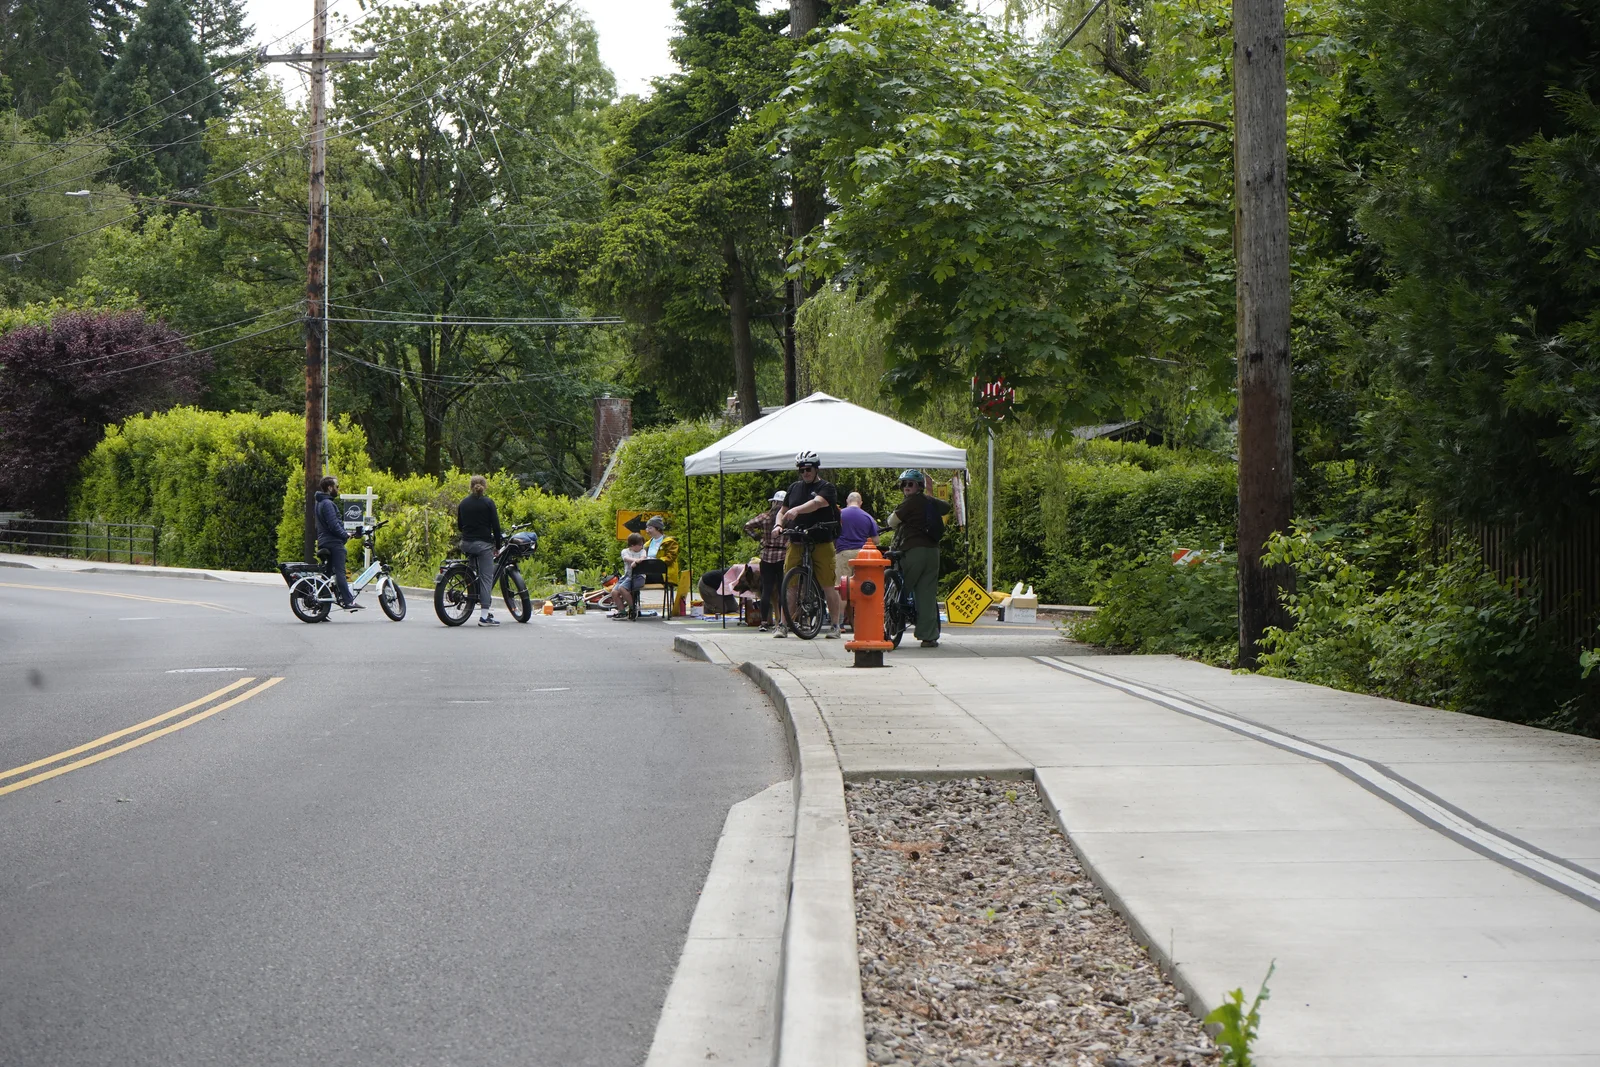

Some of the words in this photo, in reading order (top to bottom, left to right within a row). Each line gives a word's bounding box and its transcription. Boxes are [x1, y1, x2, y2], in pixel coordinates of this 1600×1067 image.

[960, 590, 979, 609] FOSSIL
[968, 587, 982, 600] NO
[951, 601, 970, 619] MONEY
[955, 595, 974, 614] FUEL
